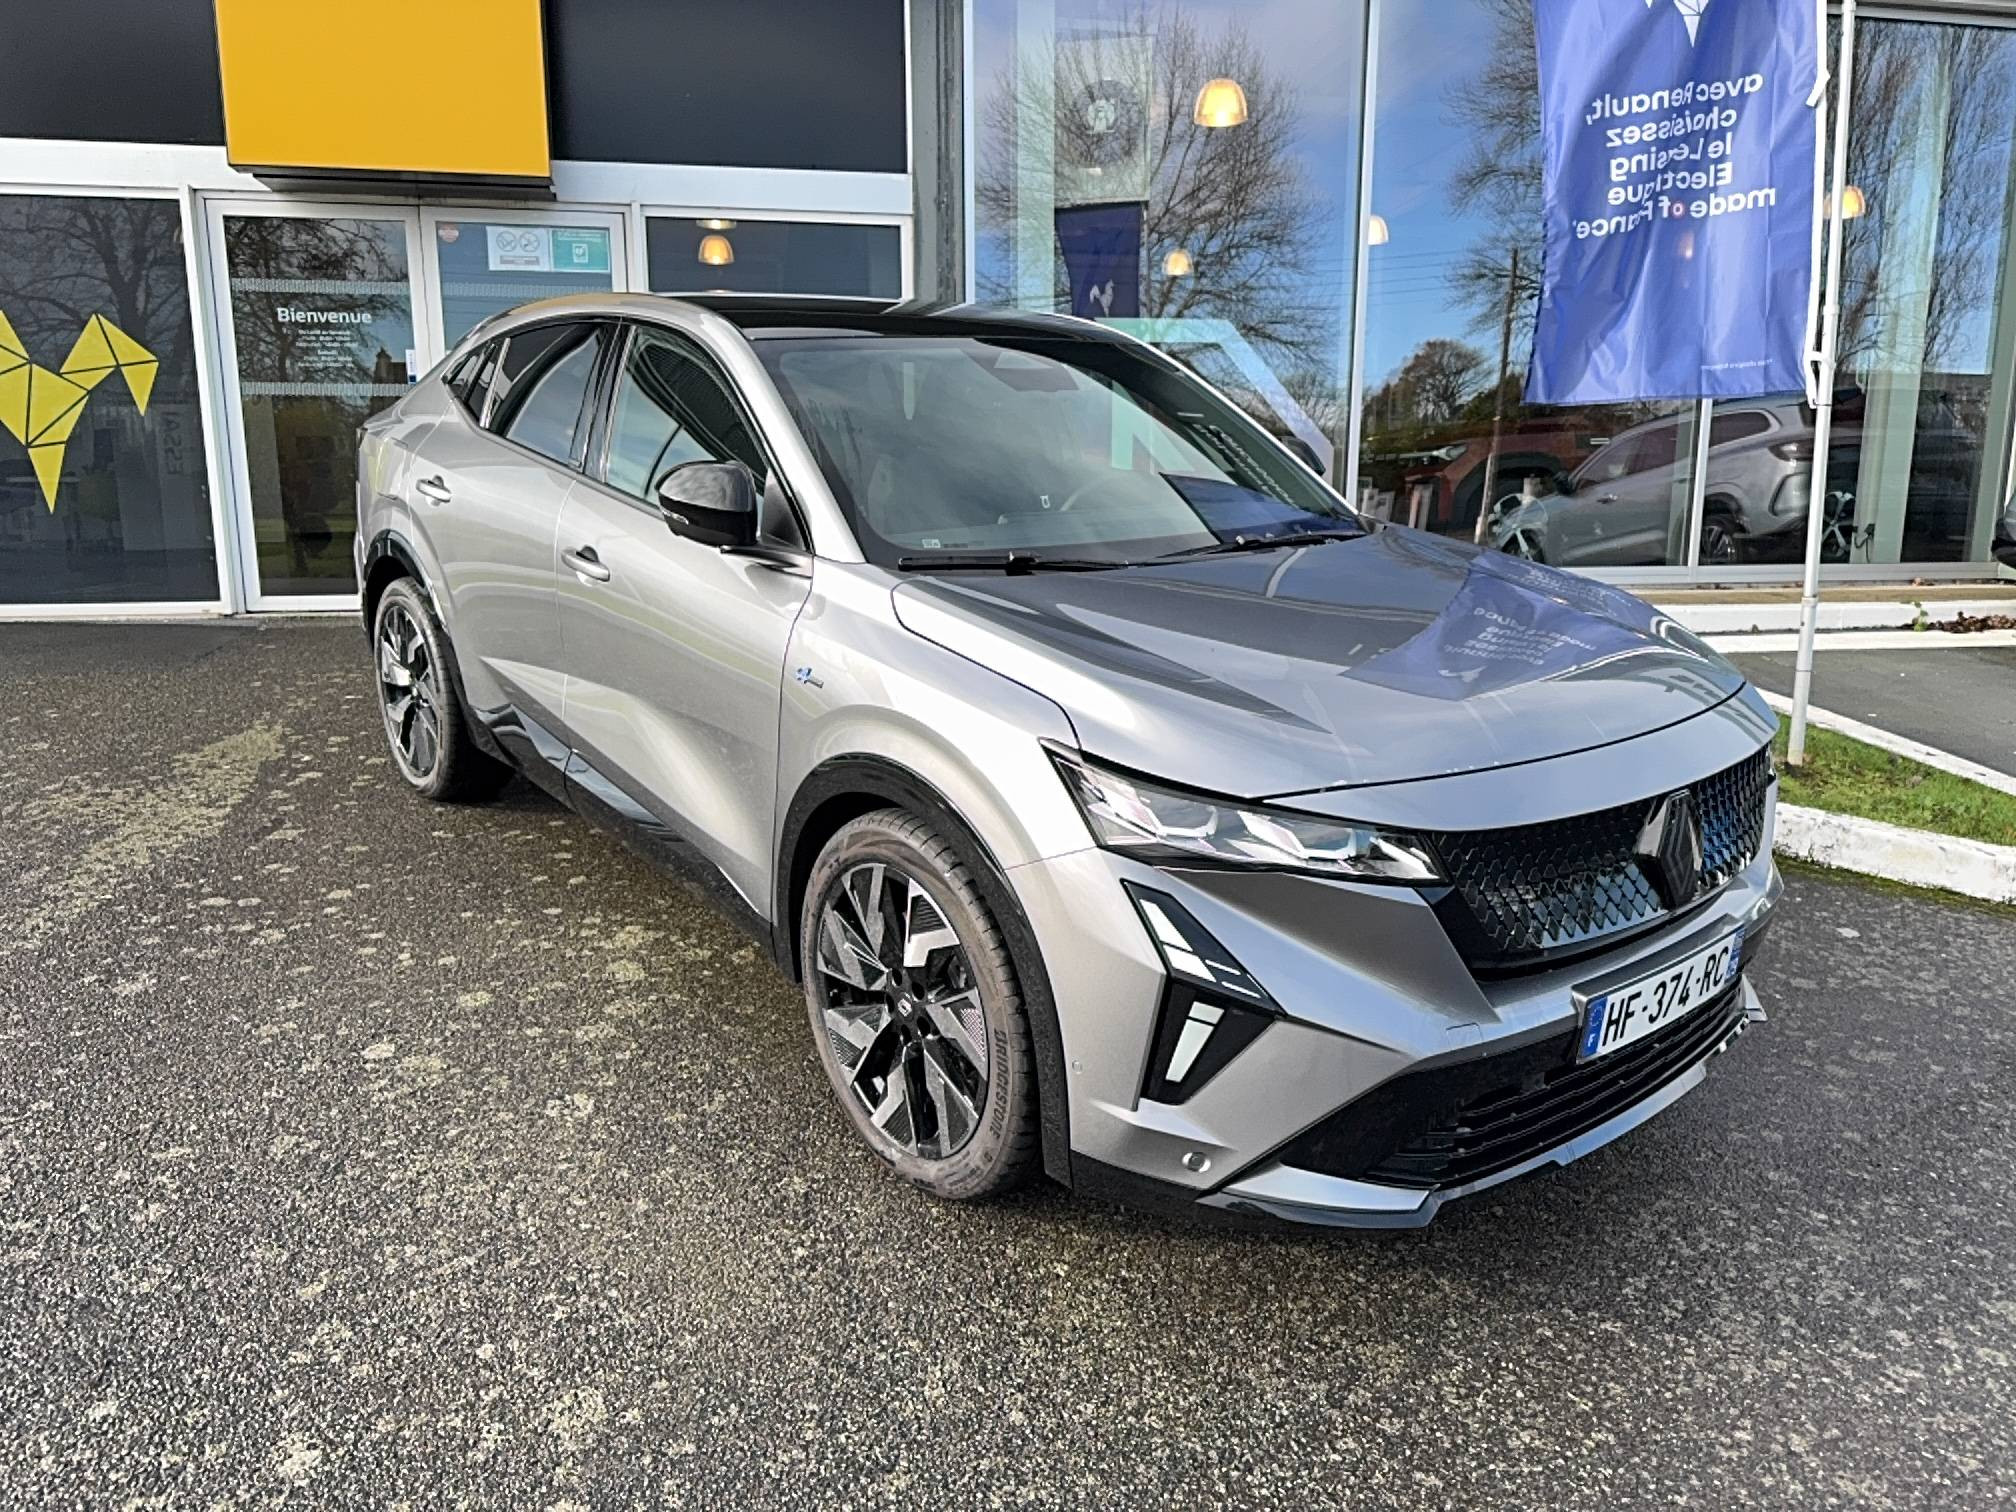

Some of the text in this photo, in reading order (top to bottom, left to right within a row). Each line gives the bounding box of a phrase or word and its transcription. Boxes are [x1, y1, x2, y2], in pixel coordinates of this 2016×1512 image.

[276, 307, 372, 324] Bienvenue
[1602, 945, 1729, 1047] HF-374-RC
[1588, 1033, 1596, 1047] F
[990, 1027, 1008, 1139] BRIDGESTONE
